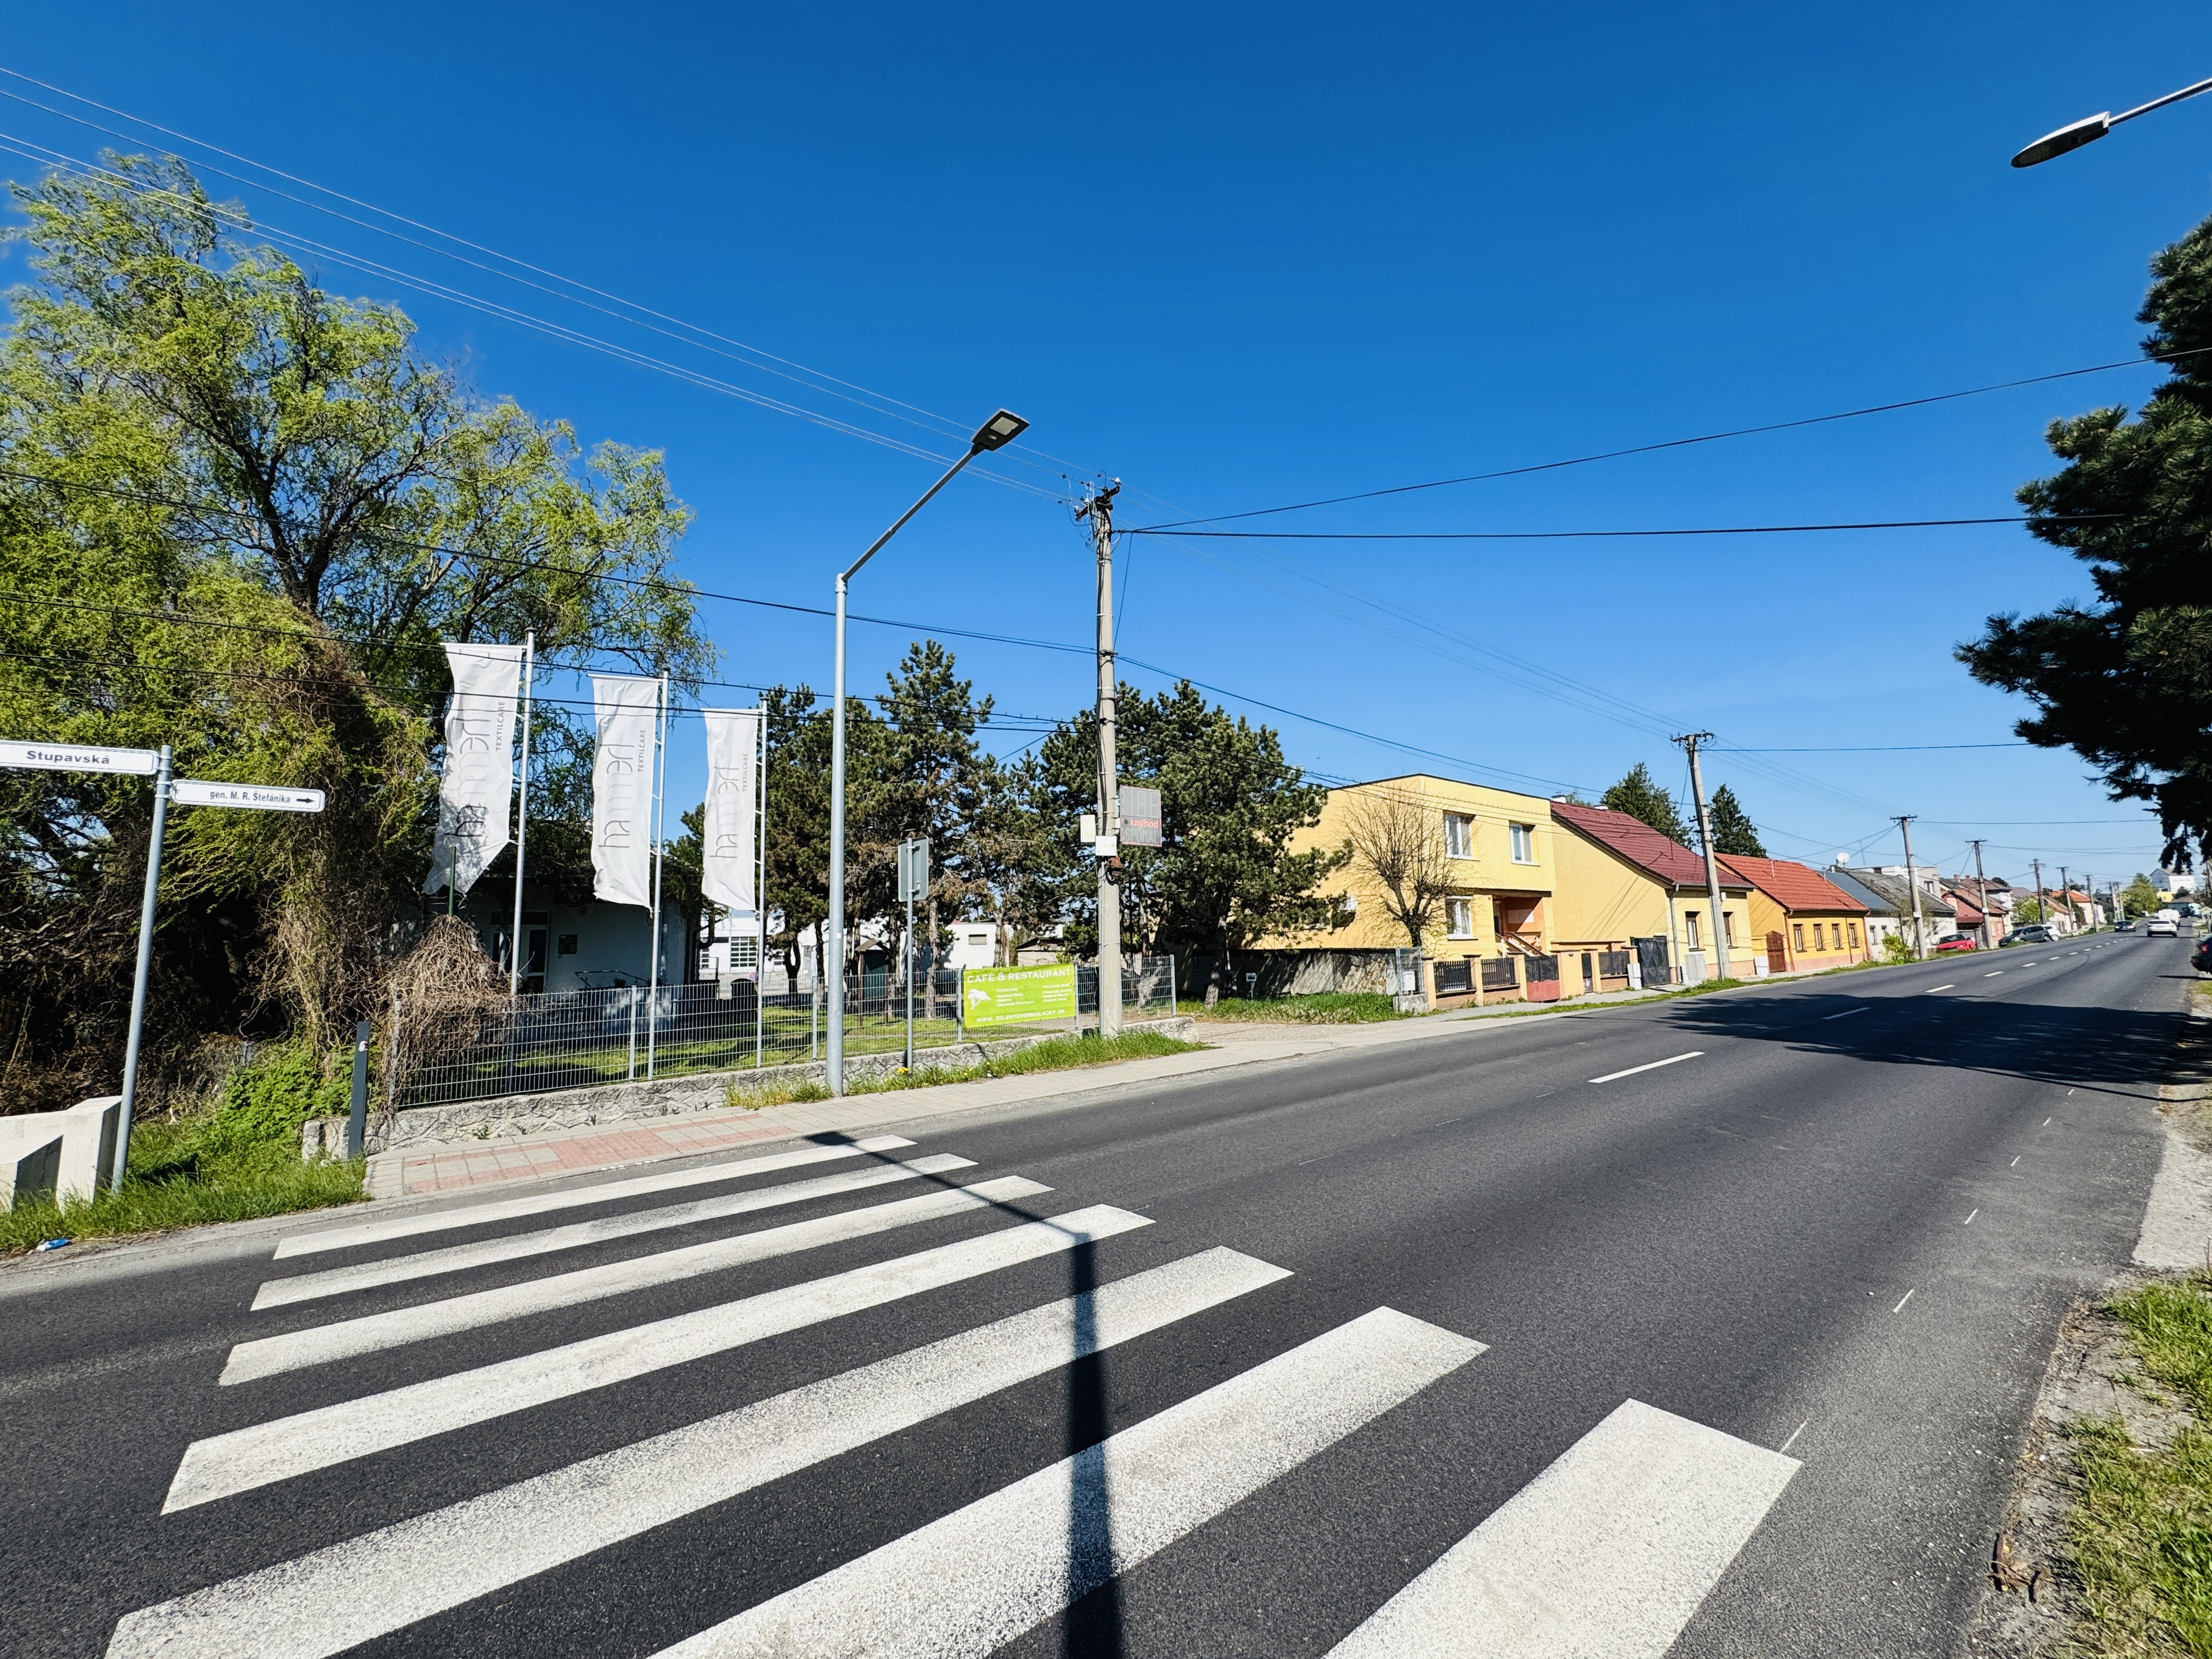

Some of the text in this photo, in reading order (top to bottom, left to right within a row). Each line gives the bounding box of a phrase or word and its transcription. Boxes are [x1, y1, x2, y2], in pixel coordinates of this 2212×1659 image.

[495, 701, 505, 751] TEXTILCARE
[26, 750, 110, 765] Stupavská
[210, 790, 290, 803] gen. M. R. Štefánika
[1130, 817, 1159, 828] km/hod
[967, 968, 1071, 983] CAFÉ & RESTAURANT
